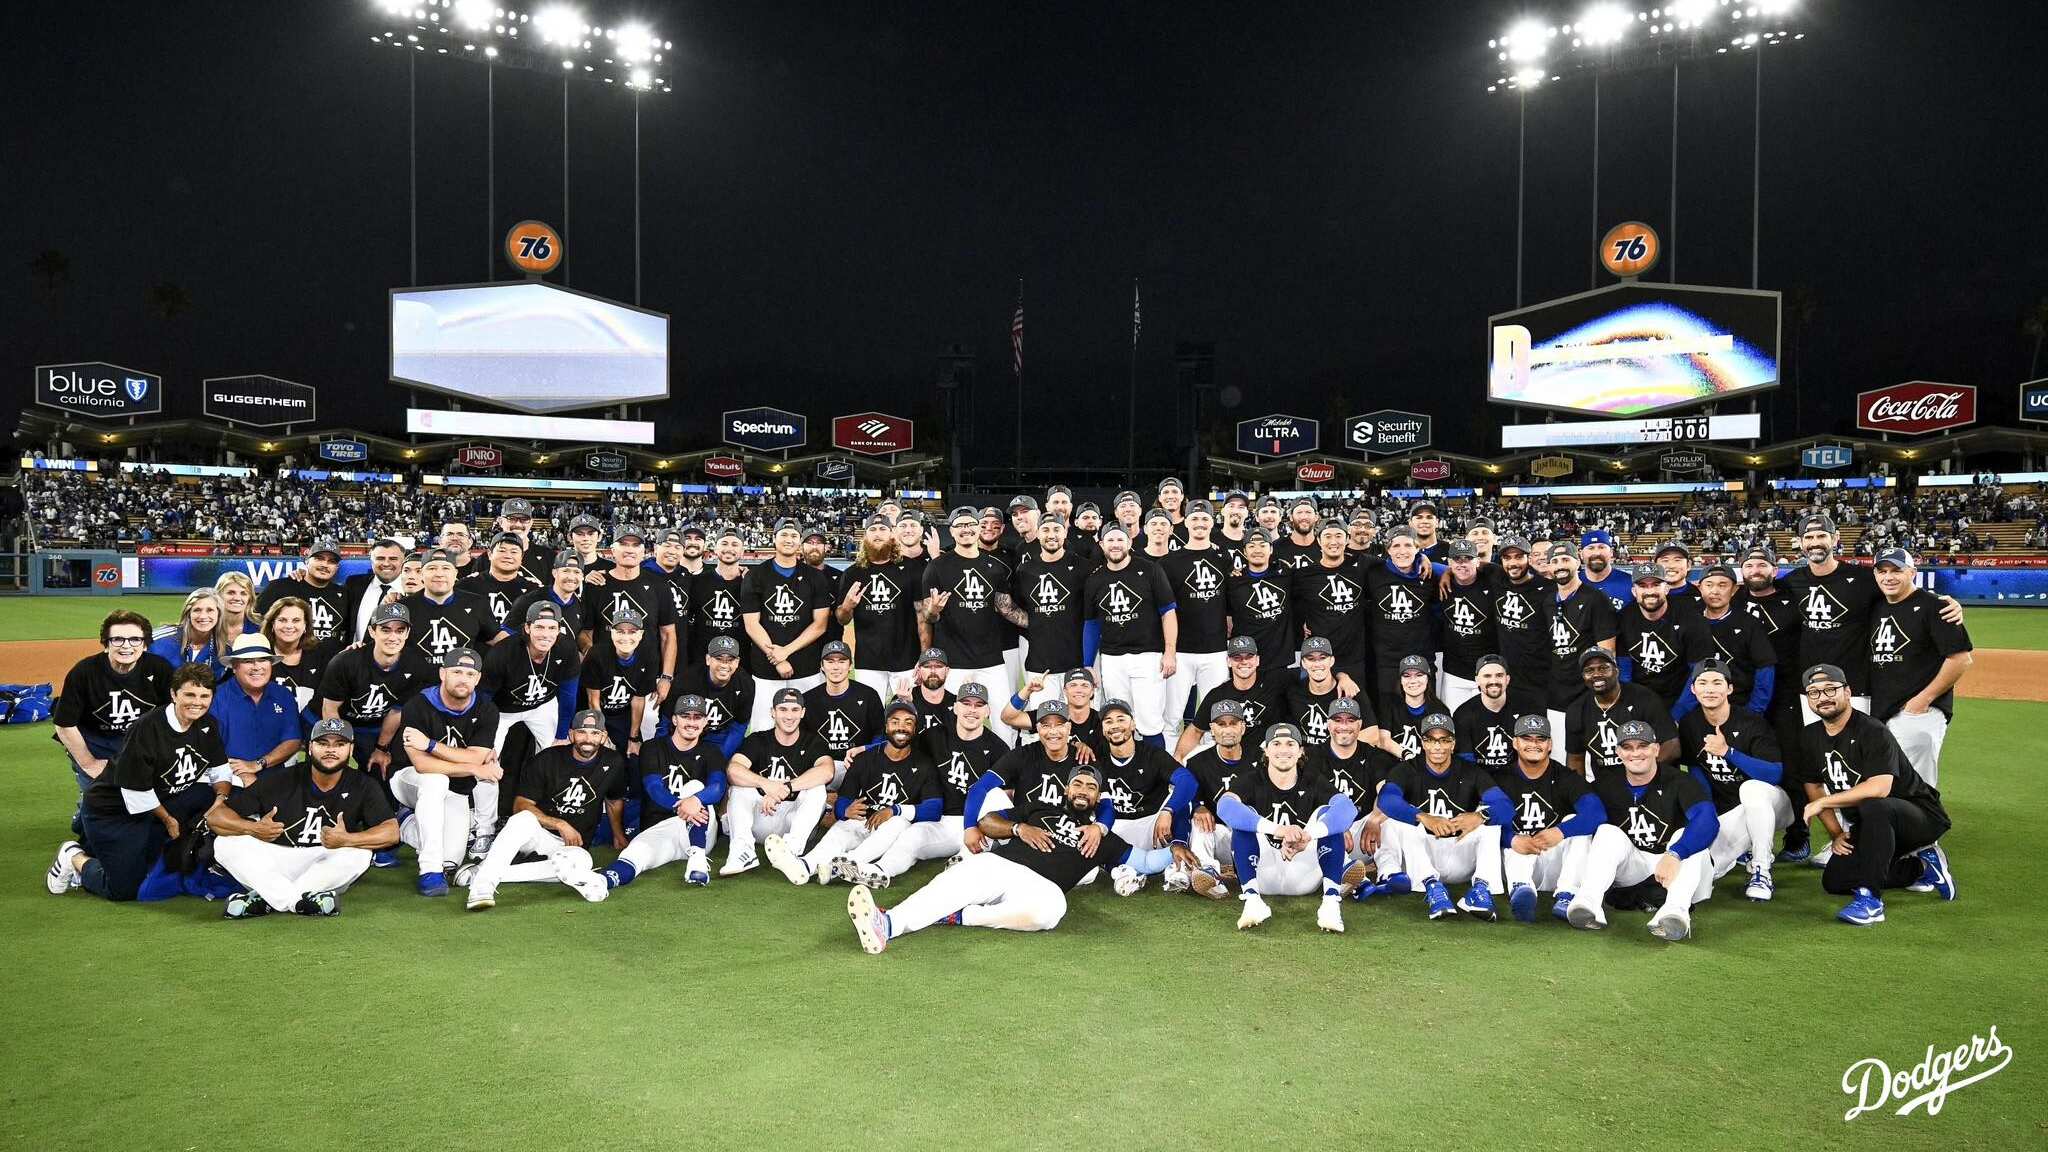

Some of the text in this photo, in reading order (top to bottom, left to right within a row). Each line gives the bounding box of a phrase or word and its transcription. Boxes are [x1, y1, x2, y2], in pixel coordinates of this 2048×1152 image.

[519, 236, 552, 260] 76
[1612, 234, 1648, 262] 76
[50, 370, 117, 395] blue
[60, 395, 125, 407] california
[213, 393, 307, 408] GUGGENHEIM
[1868, 391, 1965, 423] Coca-Cola
[733, 420, 793, 435] Spectrum
[1254, 427, 1300, 439] ULTRA
[1378, 420, 1422, 433] Security
[1674, 424, 1708, 439] 0 0 0
[1378, 432, 1416, 444] Benefit
[326, 443, 354, 451] TOYO
[330, 450, 362, 458] TIRES
[466, 450, 495, 461] JINRO
[1663, 456, 1703, 464] STARLUX
[1808, 450, 1846, 465] TEL
[707, 462, 741, 471] Yakult
[1300, 466, 1332, 480] Churu
[96, 567, 118, 583] 76
[1194, 561, 1216, 589] LA
[870, 574, 890, 601] LA
[963, 569, 984, 600] LA
[1038, 575, 1058, 603] LA
[1327, 576, 1353, 603] LA
[775, 586, 794, 614] LA
[1109, 583, 1130, 613] LA
[1197, 591, 1216, 599] NLCS
[1252, 583, 1279, 610] LA
[1391, 586, 1413, 613] LA
[1806, 586, 1832, 620] LA
[713, 591, 734, 619] LA
[871, 603, 891, 611] NLCS
[966, 601, 984, 609] NLCS
[1039, 605, 1059, 613] NLCS
[1334, 602, 1354, 611] NLCS
[1453, 598, 1474, 626] LA
[1503, 591, 1523, 619] LA
[774, 615, 794, 623] NLCS
[1111, 614, 1131, 622] NLCS
[1262, 608, 1282, 619] NLCS
[1392, 612, 1413, 620] NLCS
[712, 620, 733, 628] NLCS
[1454, 625, 1474, 635] NLCS
[1500, 618, 1520, 628] NLCS
[1808, 620, 1832, 629] NLCS
[1875, 617, 1896, 652] LA
[1640, 632, 1665, 665] LA
[1872, 654, 1894, 662] NLCS
[363, 683, 388, 713] LA
[607, 677, 630, 704] LA
[109, 690, 141, 723] LA
[274, 703, 283, 713] LA
[111, 722, 134, 731] NLC
[828, 711, 849, 741] LA
[828, 742, 849, 750] NLCS
[1487, 727, 1508, 758] LA
[175, 747, 197, 785] LA
[948, 752, 969, 785] LA
[1604, 757, 1623, 766] NLC
[1825, 752, 1851, 789] LA
[563, 778, 588, 807] LA
[878, 773, 898, 805] LA
[1038, 774, 1062, 806] LA
[1521, 793, 1545, 829] LA
[1628, 807, 1657, 842] LA
